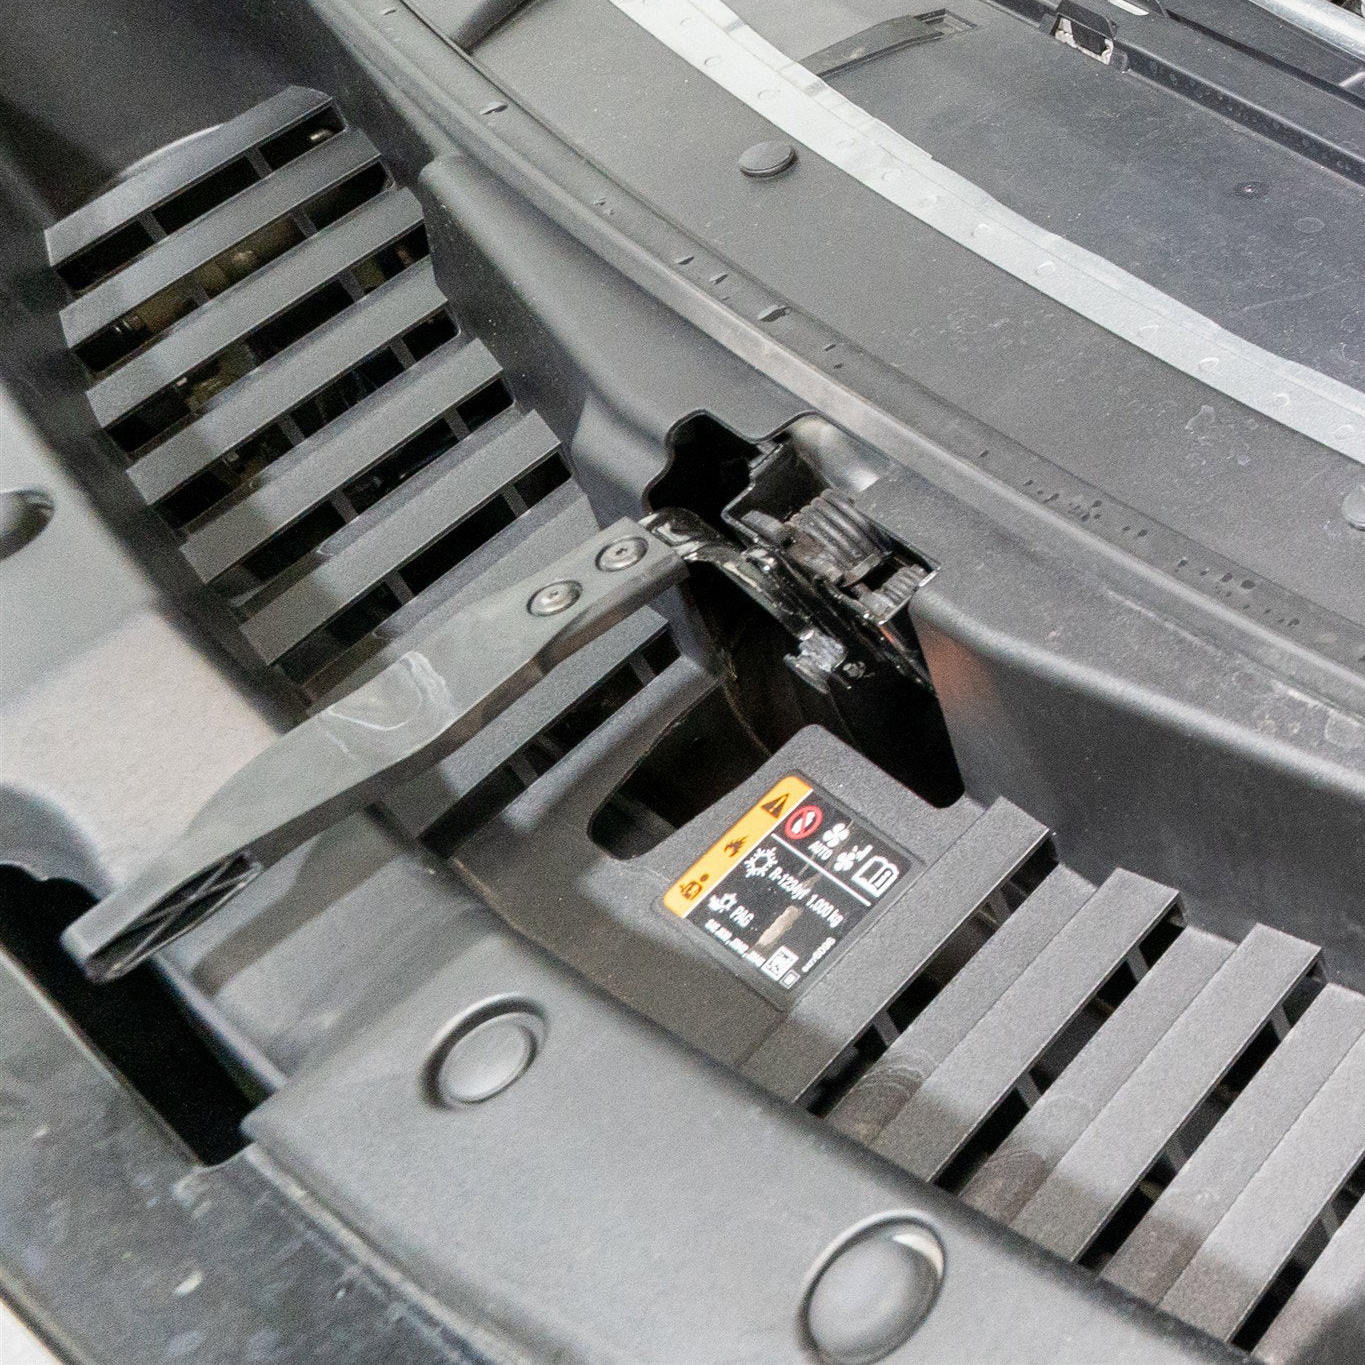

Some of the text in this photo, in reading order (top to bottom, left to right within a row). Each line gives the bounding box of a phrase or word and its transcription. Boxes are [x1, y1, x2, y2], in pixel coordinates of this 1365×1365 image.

[807, 840, 832, 860] AUTO
[729, 905, 755, 928] PAG
[806, 894, 835, 919] 1.000
[827, 908, 844, 928] kg
